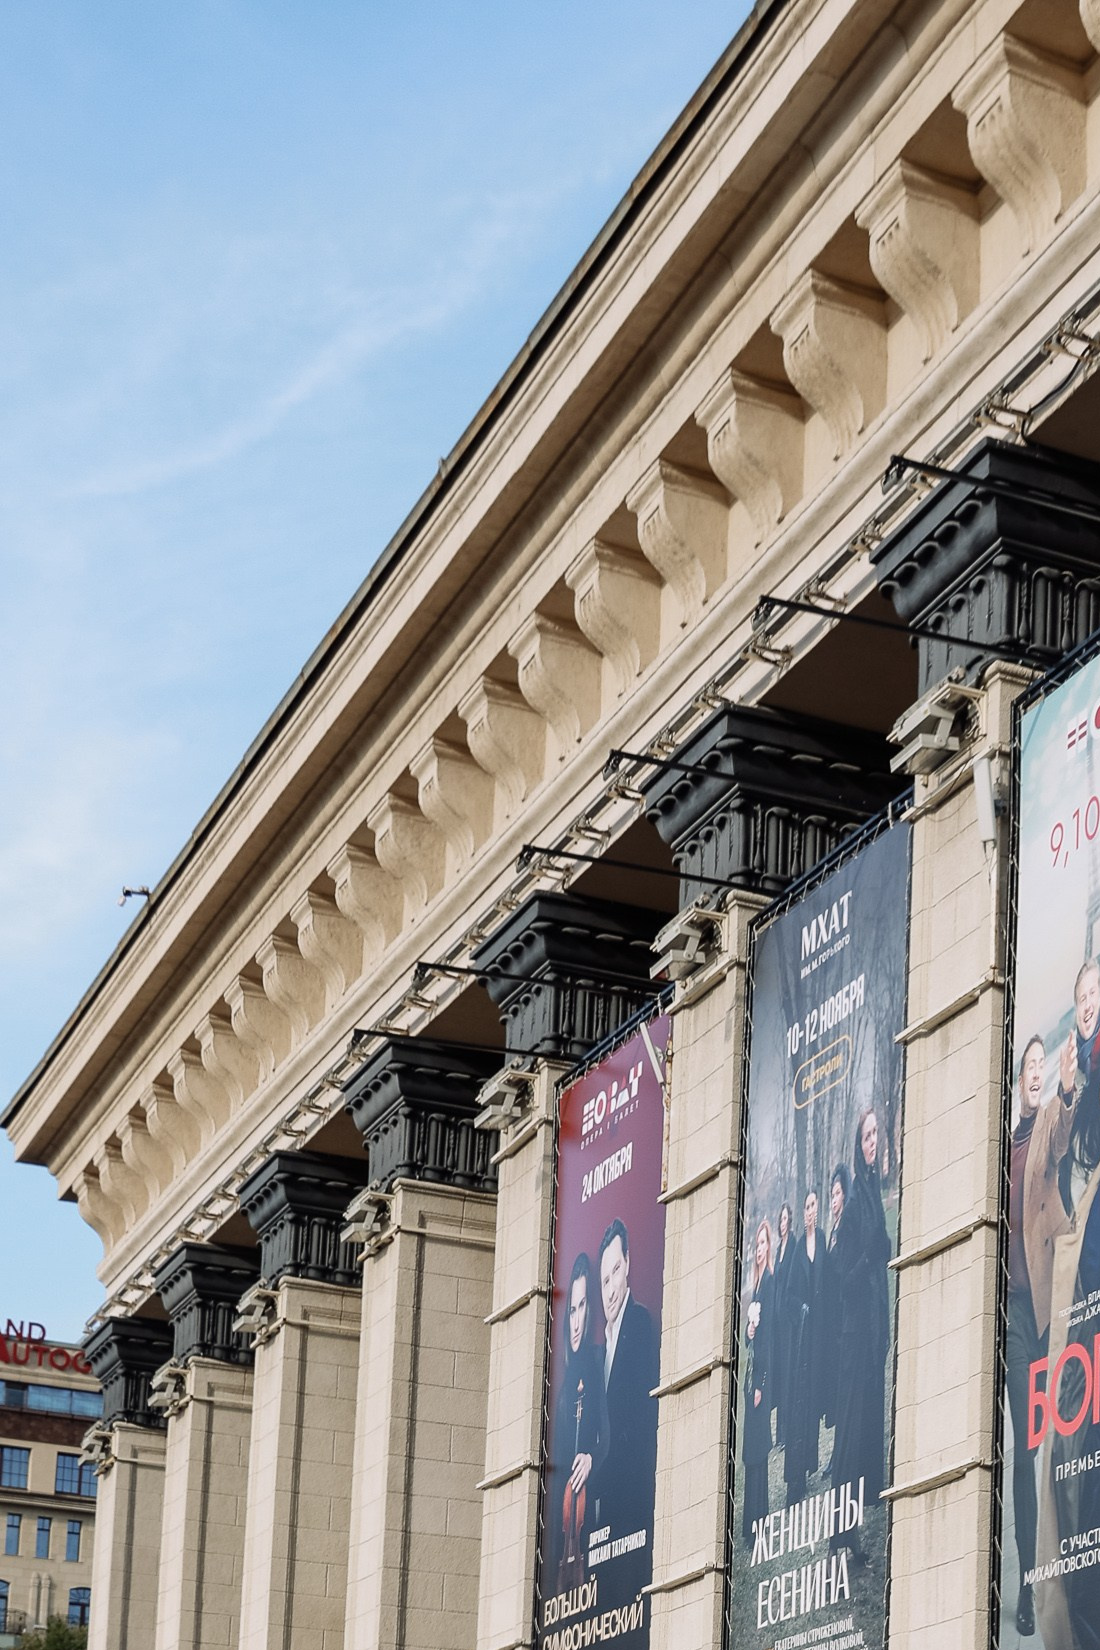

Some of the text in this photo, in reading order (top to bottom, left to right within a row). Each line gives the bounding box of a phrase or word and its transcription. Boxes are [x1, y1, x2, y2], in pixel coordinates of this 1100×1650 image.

[801, 890, 853, 961] МХАТ
[818, 933, 851, 966] ГОРЬКОГО
[786, 972, 865, 1058] 10-12 НОЯБРЯ
[801, 1052, 844, 1092] ГАСТРОЛИ
[580, 1099, 640, 1150] ОПЕРА БАЛЕТ
[581, 1141, 633, 1203] 24 ОКТЯБРЯ
[611, 1528, 647, 1558] ТАТАРНИКОВ
[750, 1475, 865, 1568] ЖЕНЩИНЫ
[1060, 1540, 1068, 1555] С
[543, 1573, 598, 1628] БОЛЬШОЙ
[757, 1551, 850, 1629] ЕСЕНИНА
